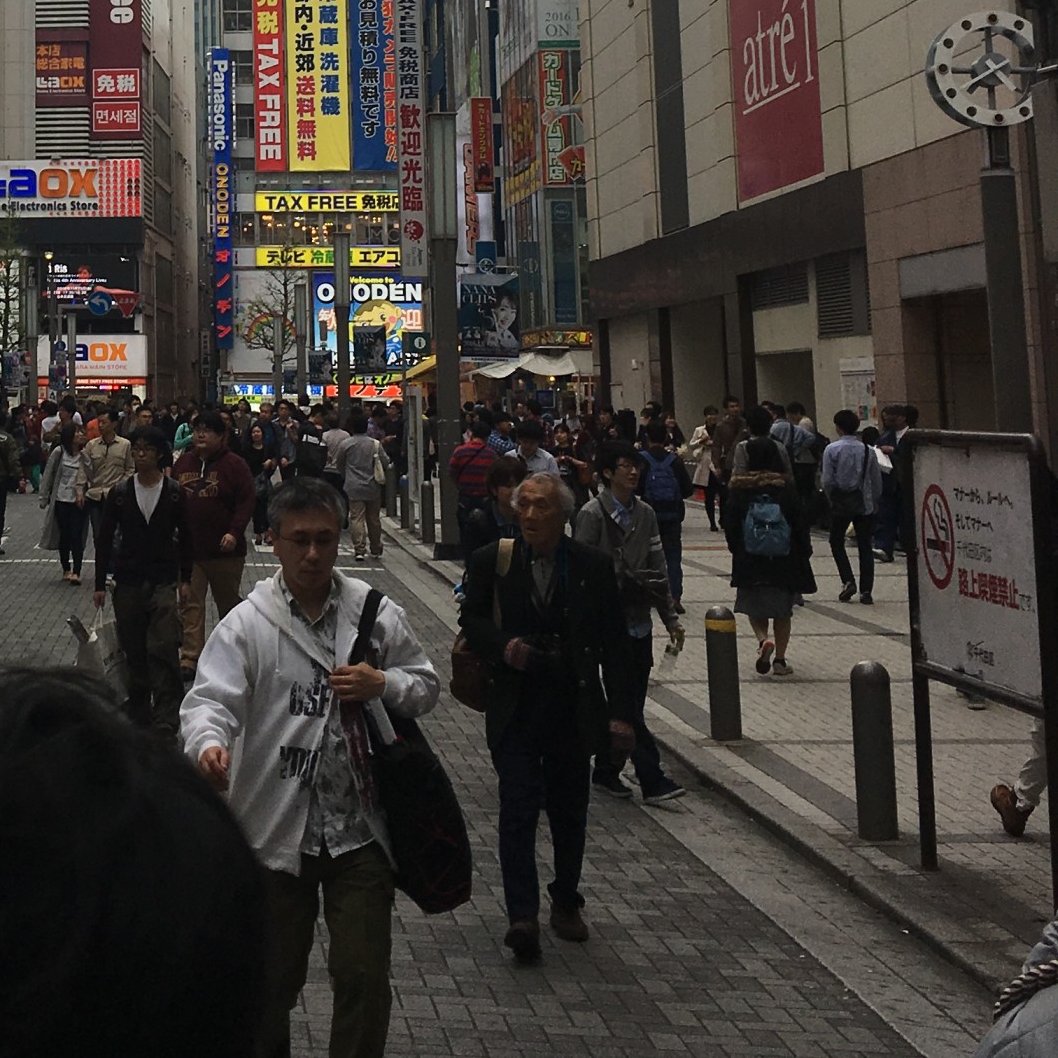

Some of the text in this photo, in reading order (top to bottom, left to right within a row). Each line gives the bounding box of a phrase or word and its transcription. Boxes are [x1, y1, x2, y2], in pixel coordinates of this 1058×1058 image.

[545, 26, 570, 38] ON
[36, 45, 61, 57] 本店
[36, 57, 85, 70] 総合家電
[257, 38, 280, 88] TAX
[398, 46, 419, 100] 免税商店
[97, 74, 136, 93] 免税
[212, 60, 229, 150] Panasonic
[96, 109, 137, 124] 면세점
[543, 52, 567, 184] カードゲム専門店
[258, 94, 282, 161] FREE
[400, 104, 424, 212] 歓迎光臨
[11, 200, 67, 213] Electronics
[70, 200, 99, 212] Store
[215, 163, 230, 238] ONODEN
[265, 196, 303, 210] TAX
[308, 195, 357, 209] FREE
[267, 250, 306, 264] テレビ
[216, 249, 232, 339] オノデン
[317, 283, 422, 302] OODEN
[462, 284, 497, 294] NANA
[462, 294, 498, 305] CLIPS
[955, 514, 994, 532] そしてマナーへ
